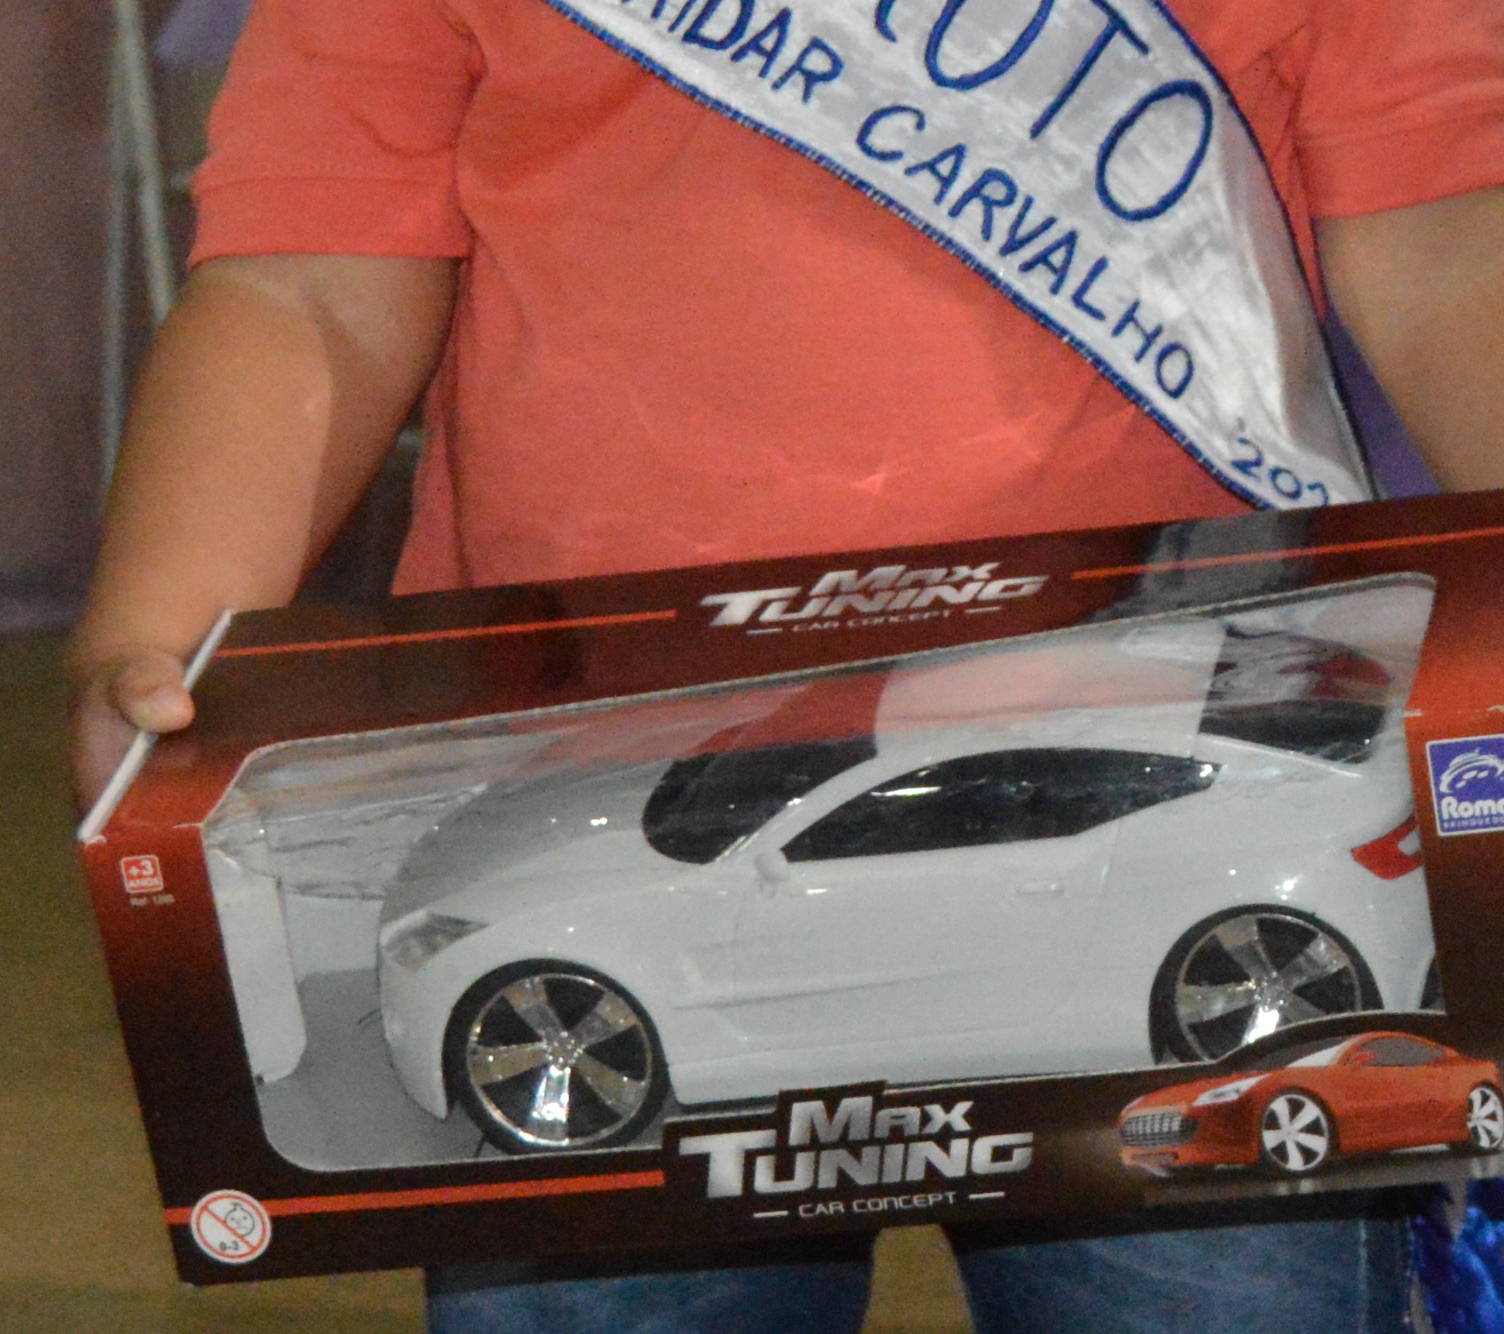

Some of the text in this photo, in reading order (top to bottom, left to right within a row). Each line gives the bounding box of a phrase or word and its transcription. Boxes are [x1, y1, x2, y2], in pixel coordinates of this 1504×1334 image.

[857, 105, 1194, 395] CARVALHO
[798, 1190, 957, 1218] CAR CONCEPT
